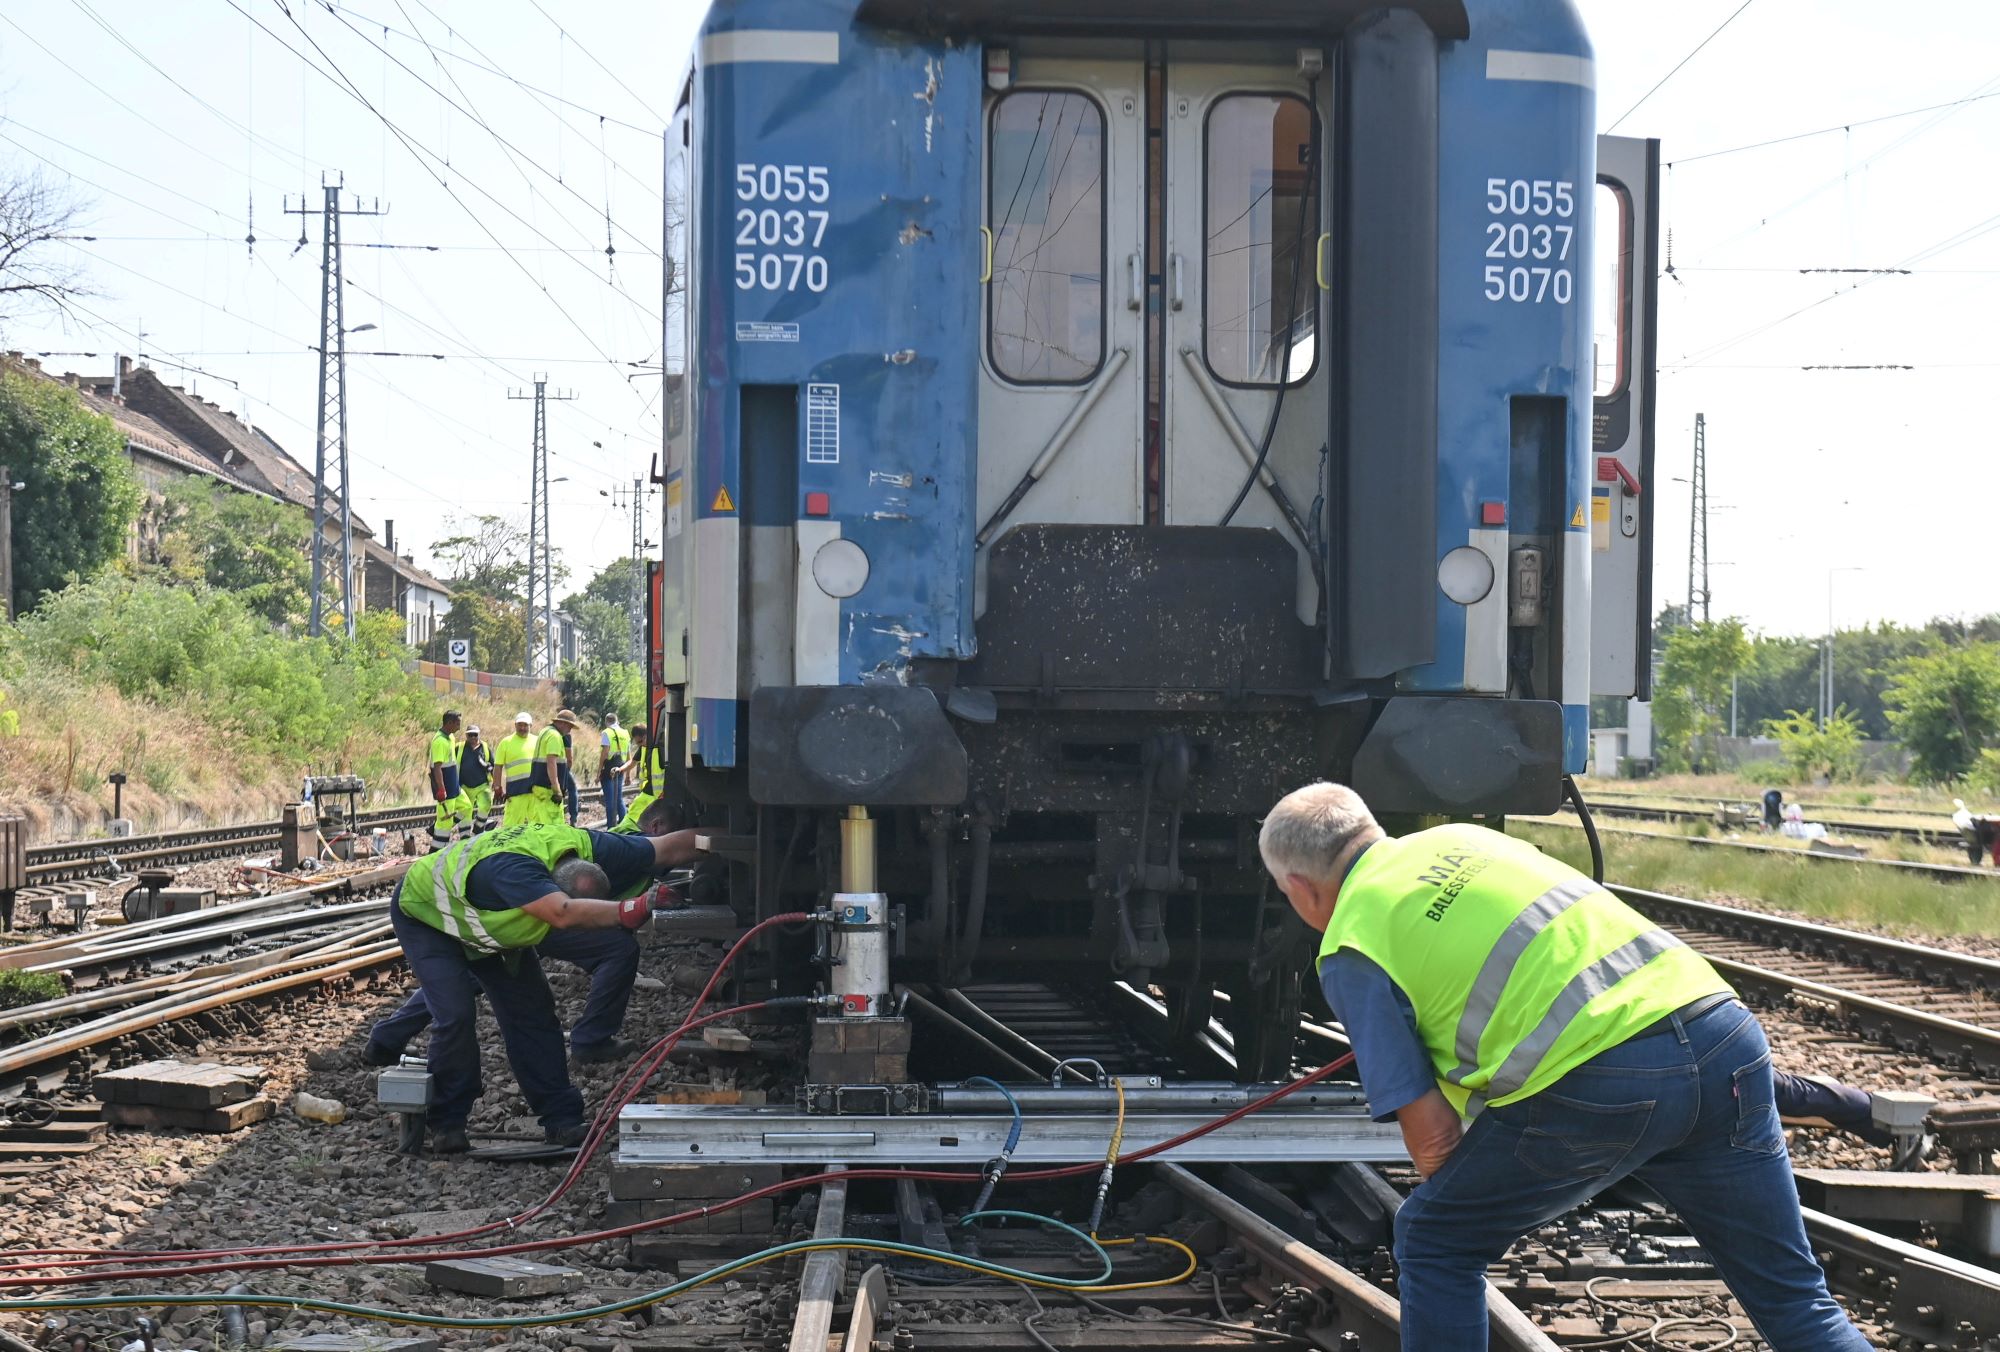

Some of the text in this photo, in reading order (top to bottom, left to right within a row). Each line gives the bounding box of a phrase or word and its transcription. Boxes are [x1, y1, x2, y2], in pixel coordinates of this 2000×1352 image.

[737, 163, 829, 203] 5055
[1487, 177, 1574, 218] 5055
[736, 208, 829, 248] 2037
[1486, 222, 1573, 261] 2037
[736, 253, 828, 292] 5070
[1485, 265, 1572, 304] 5070
